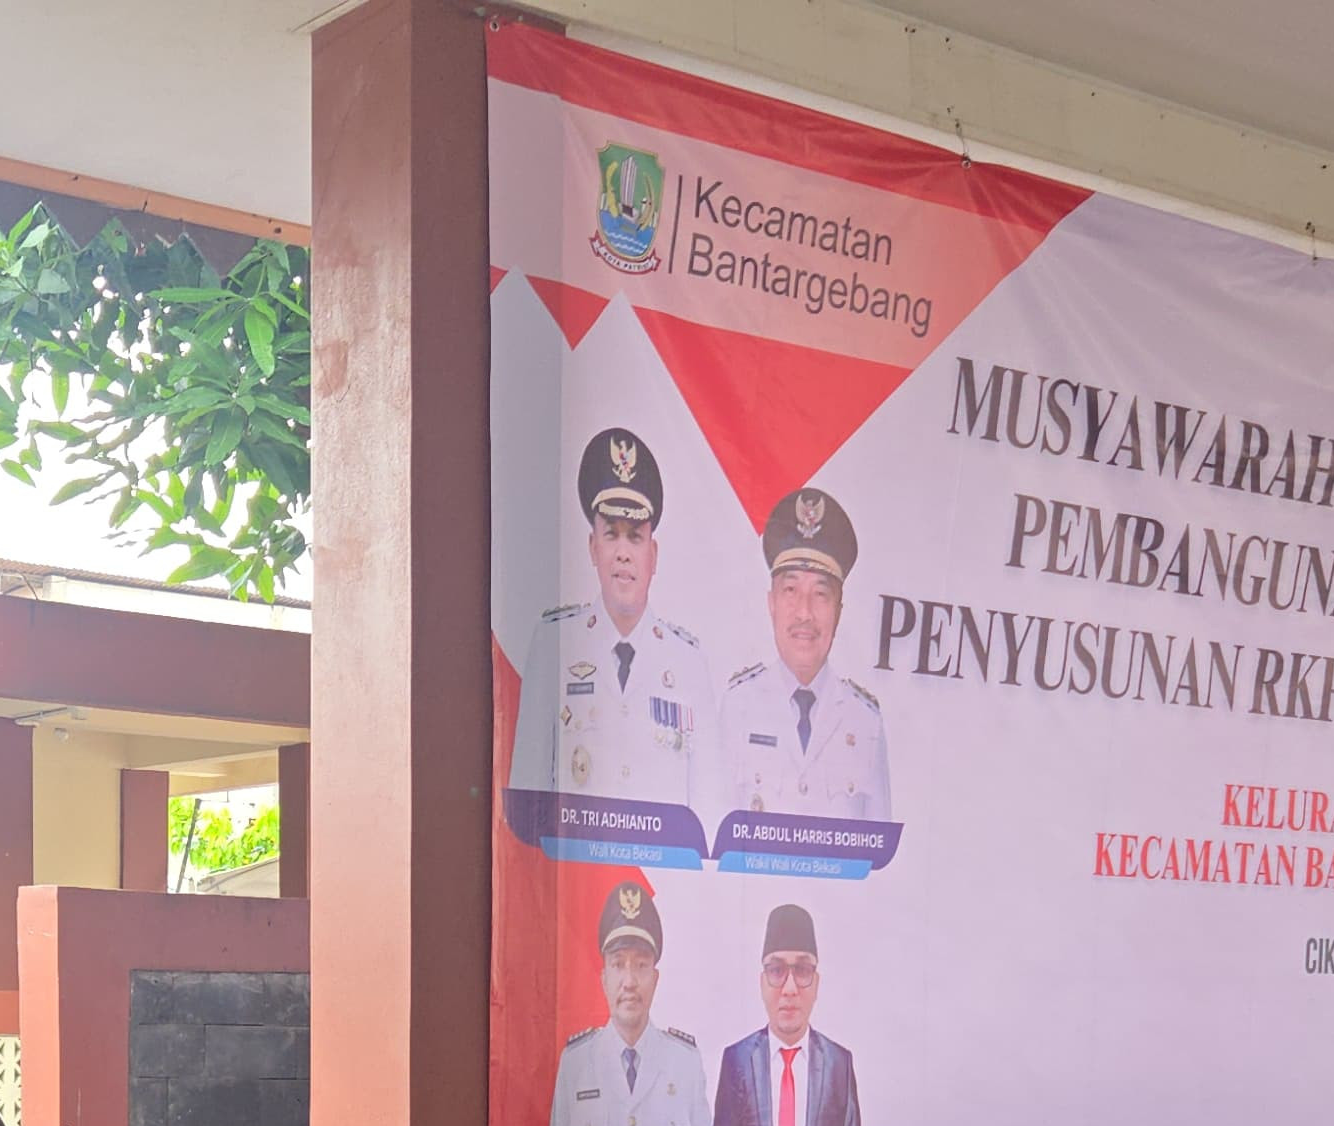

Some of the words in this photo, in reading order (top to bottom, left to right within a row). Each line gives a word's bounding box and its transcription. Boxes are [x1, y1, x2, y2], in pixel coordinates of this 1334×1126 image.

[693, 176, 893, 265] Kecamatan
[688, 234, 933, 337] Bantargebang
[874, 594, 1245, 712] PENYUSUNAN
[561, 807, 580, 825] DR.
[581, 810, 599, 827] TRI
[601, 812, 662, 832] ADHIANTO
[733, 823, 751, 839] DR.
[753, 825, 791, 843] ABDUL
[793, 828, 833, 846] HARRIS
[835, 832, 884, 849] BOBIHOE
[1092, 832, 1298, 887] KECAMATAN
